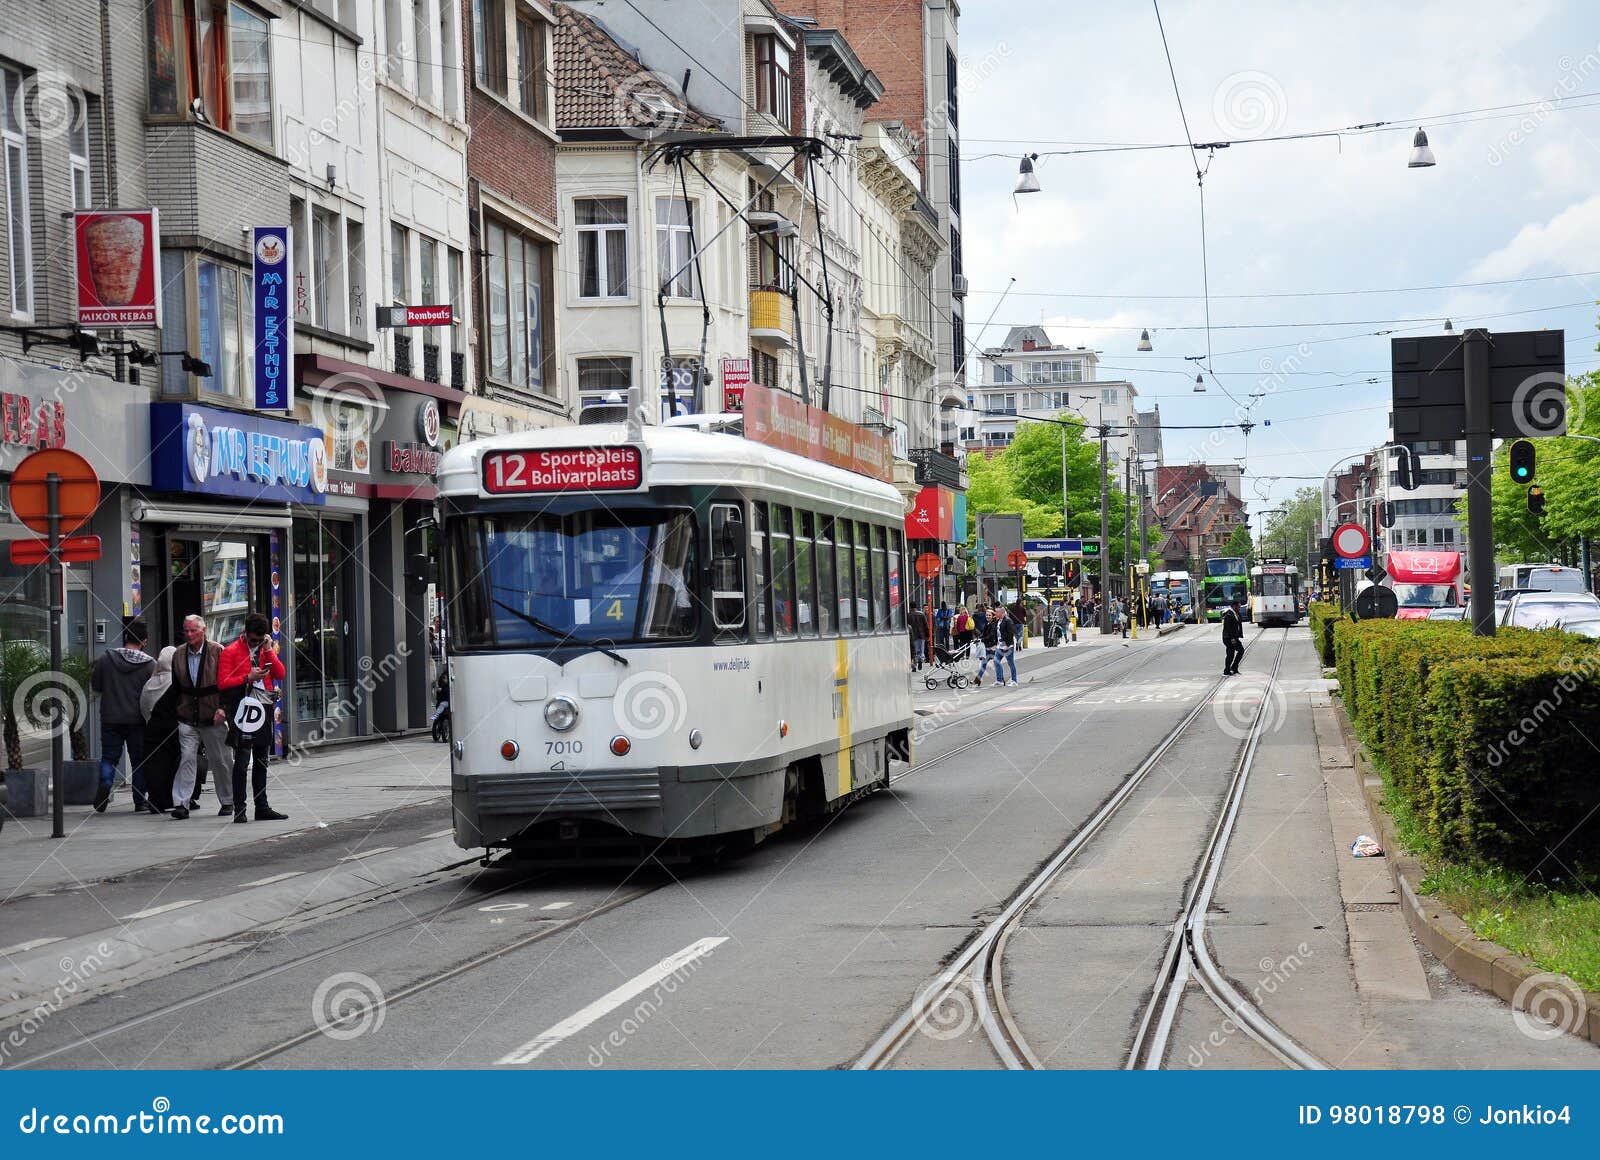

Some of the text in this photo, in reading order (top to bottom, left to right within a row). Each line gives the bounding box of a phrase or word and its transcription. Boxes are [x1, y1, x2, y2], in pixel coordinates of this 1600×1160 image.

[81, 312, 153, 321] MIXOR KEBAB
[407, 310, 450, 321] Rombouts
[264, 316, 280, 405] EETHUIS
[540, 448, 635, 468] Sportpaleis
[489, 454, 527, 487] 12
[531, 467, 636, 486] Bolivarplaats
[606, 599, 624, 621] 4
[713, 657, 751, 672] www.delijn.be
[238, 705, 262, 724] JD
[545, 741, 583, 755] 7010
